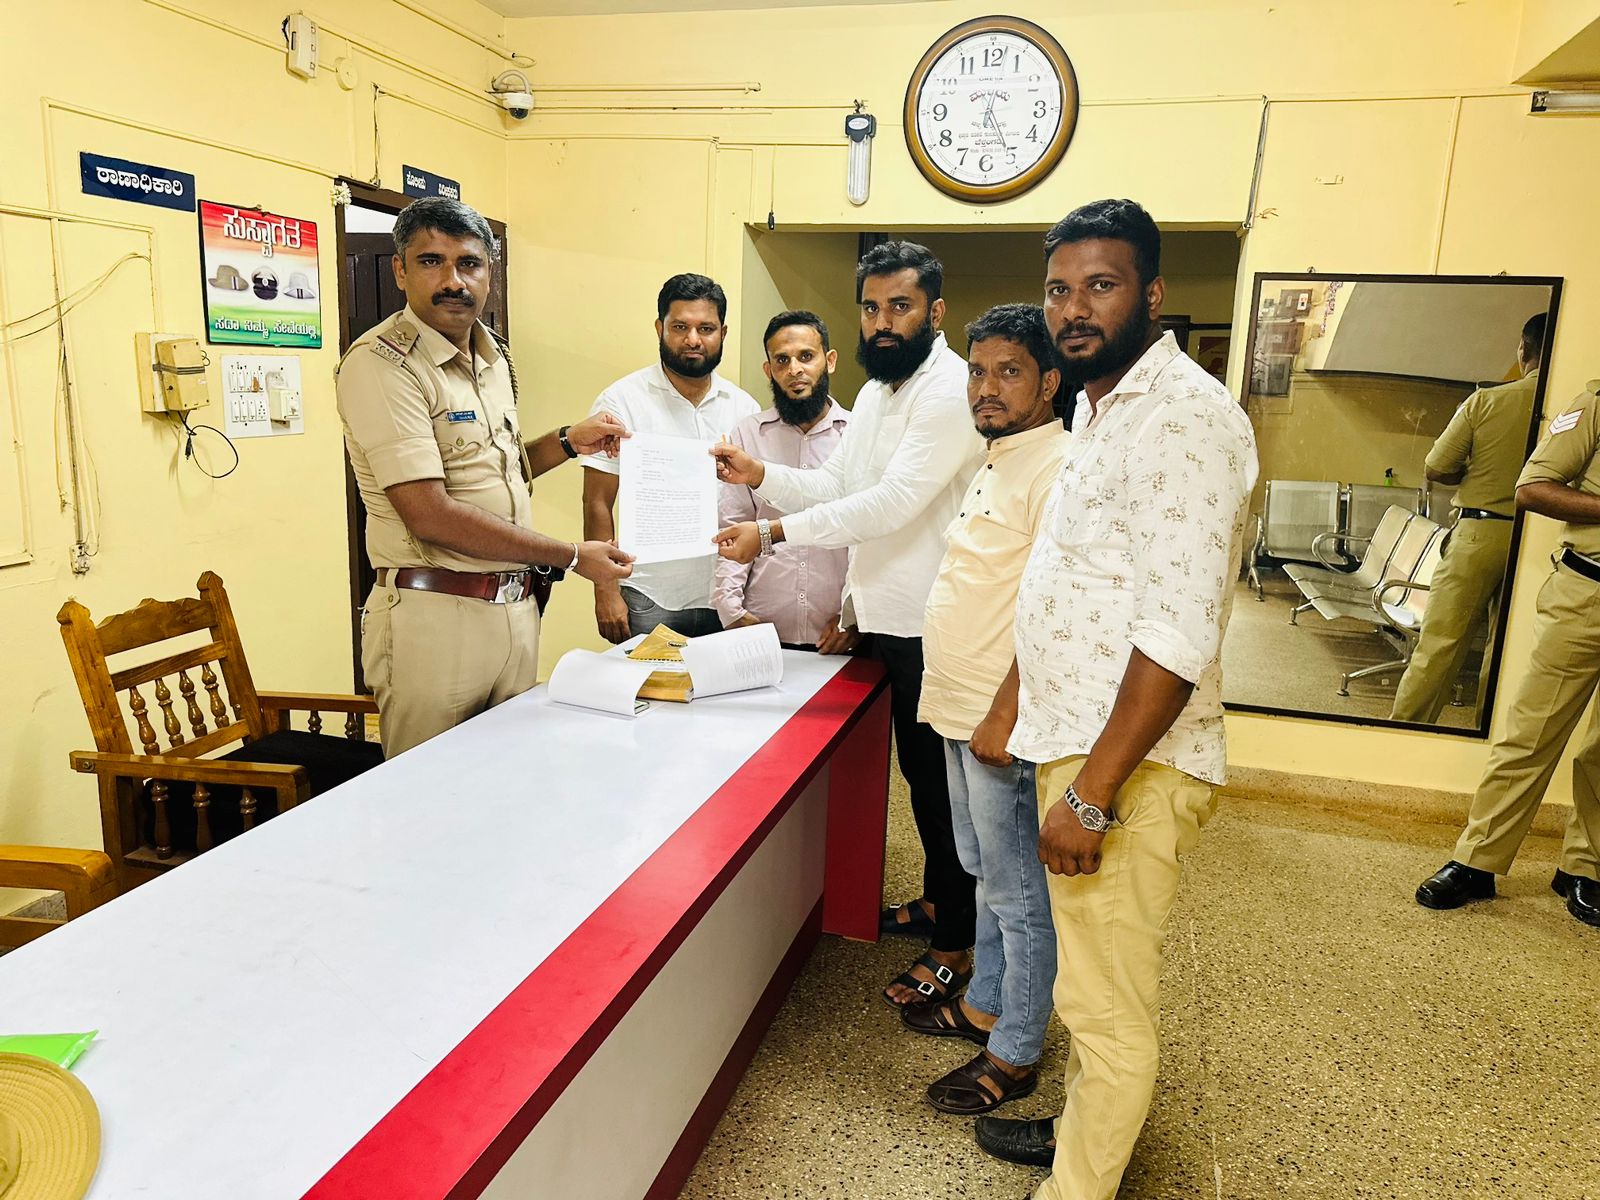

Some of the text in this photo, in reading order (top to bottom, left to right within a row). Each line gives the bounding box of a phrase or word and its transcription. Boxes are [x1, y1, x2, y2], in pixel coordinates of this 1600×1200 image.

[959, 56, 975, 75] 11
[982, 48, 1003, 67] 12
[1013, 54, 1021, 74] 1
[933, 103, 948, 122] 9
[1033, 100, 1047, 119] 3
[939, 129, 953, 147] 8
[1025, 124, 1038, 143] 4
[957, 147, 969, 166] 7
[979, 154, 994, 172] 6
[1005, 146, 1018, 165] 5
[222, 209, 301, 257] ಸುಸ್ವಾಗತ
[215, 316, 317, 339] ಸದಾ ನಿಮ್ಮ ಸೇವೆಯಲ್ಲಿ
